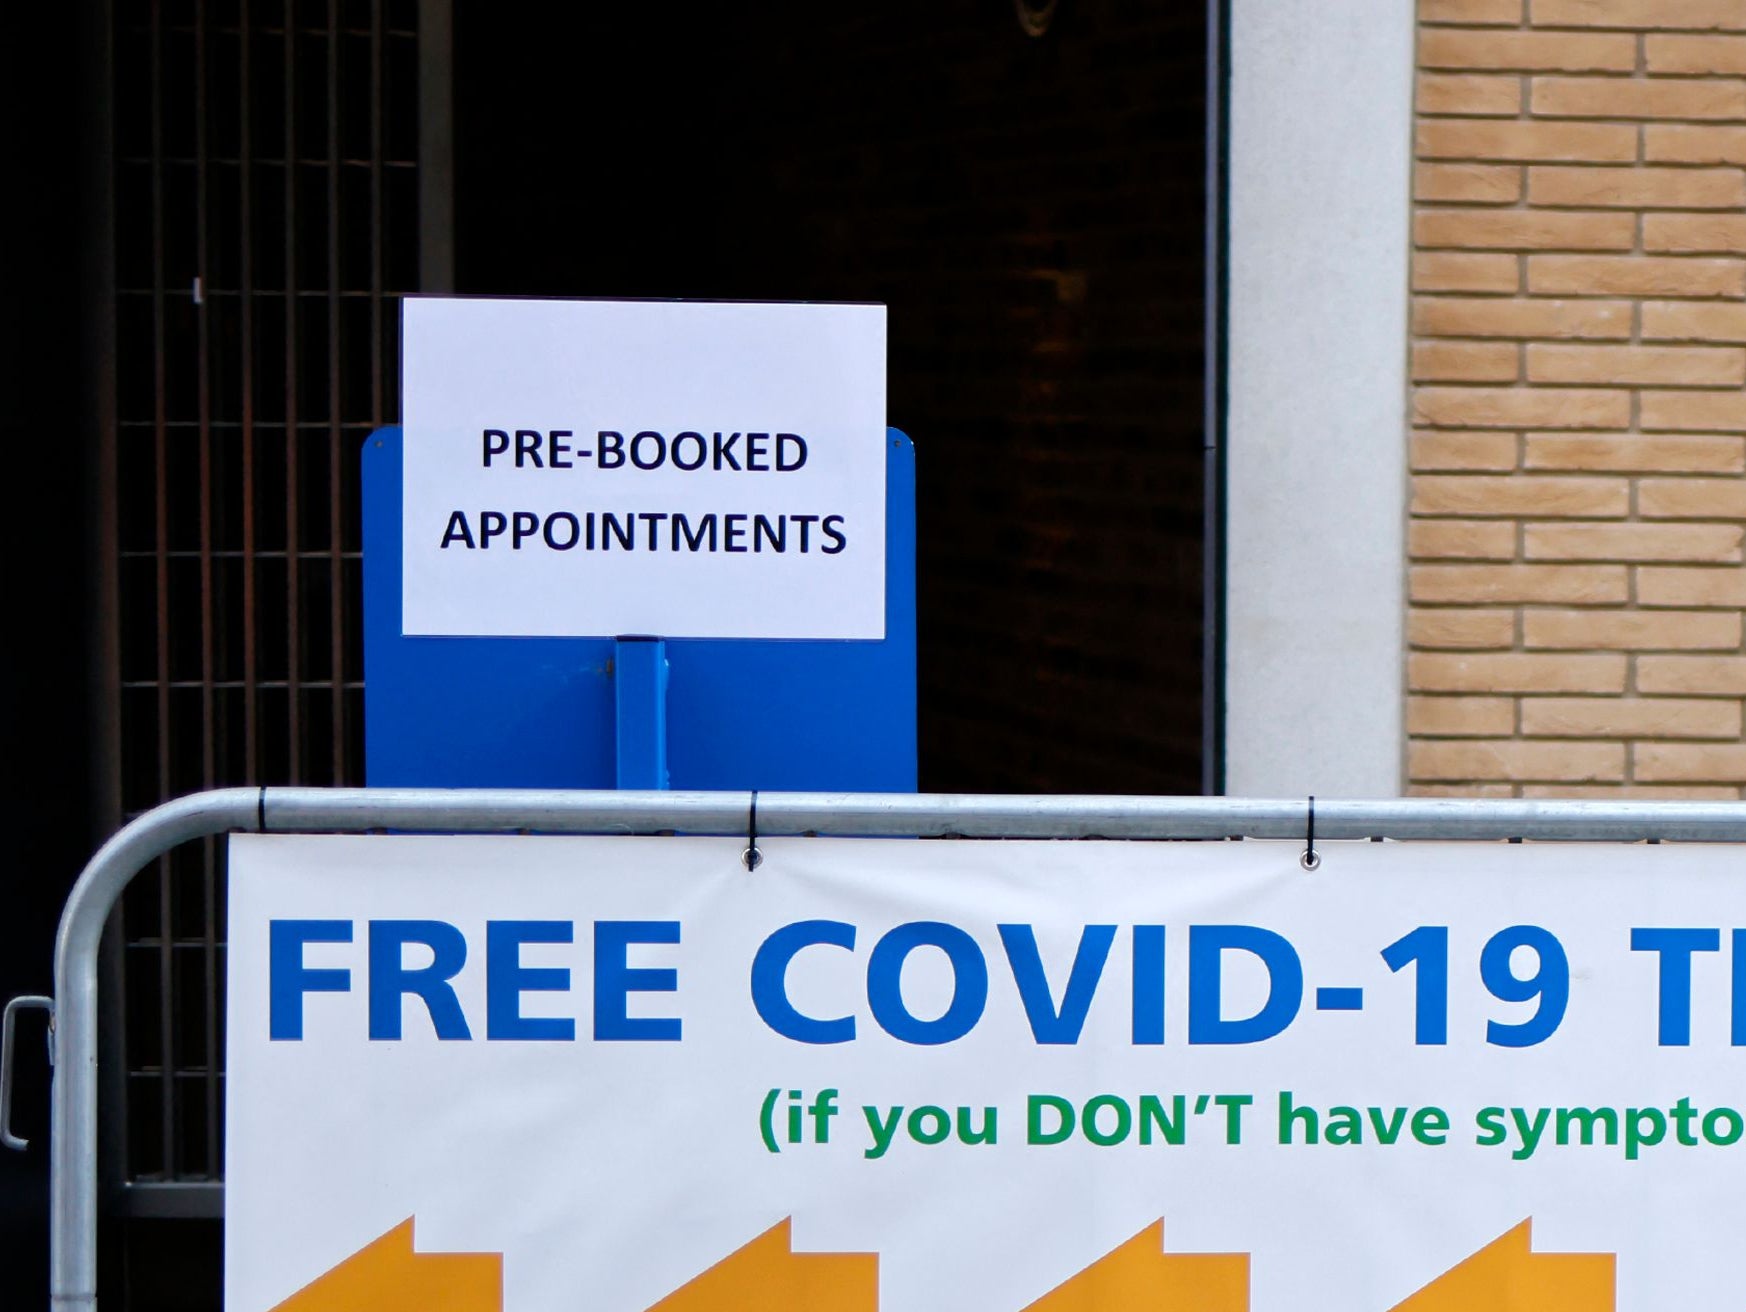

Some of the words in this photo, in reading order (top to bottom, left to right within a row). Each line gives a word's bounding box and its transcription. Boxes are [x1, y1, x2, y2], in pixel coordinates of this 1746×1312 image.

[482, 429, 809, 473] PRE-BOOKED
[440, 511, 848, 555] APPOINTMENTS
[271, 920, 684, 1042] FREE
[752, 920, 1571, 1049] COVID-19
[759, 1088, 840, 1154] (if
[862, 1105, 999, 1161] you
[1027, 1094, 1255, 1148] DON’T
[1278, 1090, 1451, 1147] have
